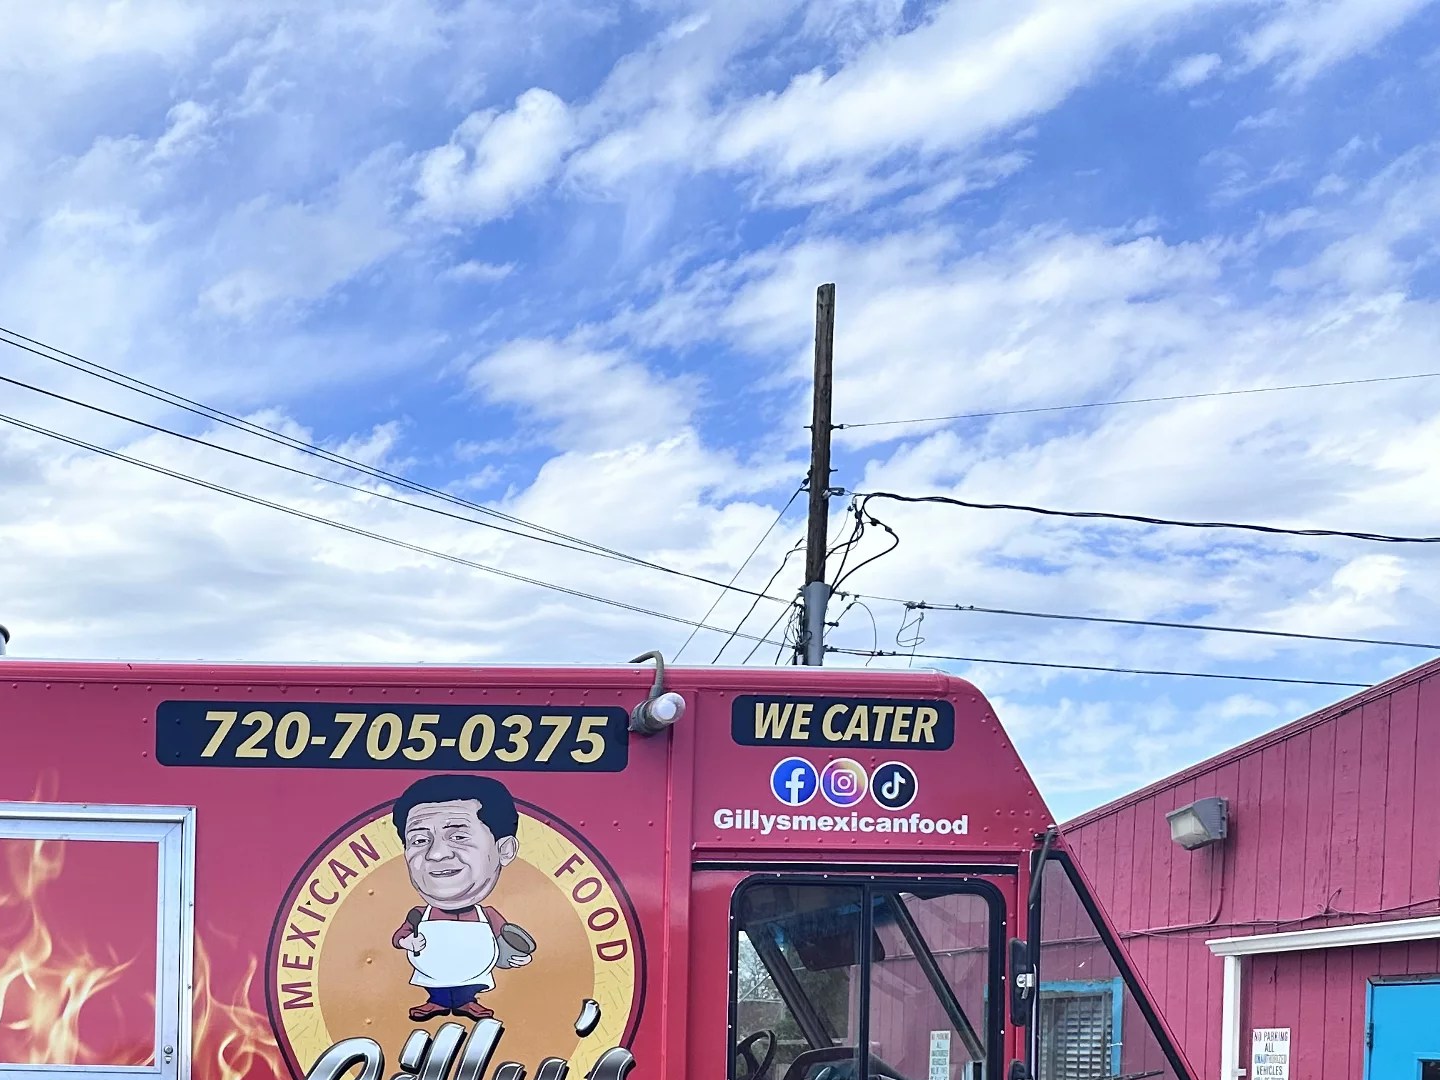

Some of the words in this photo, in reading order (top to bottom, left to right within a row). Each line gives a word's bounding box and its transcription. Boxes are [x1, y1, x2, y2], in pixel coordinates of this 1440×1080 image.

[754, 703, 813, 740] WE
[822, 704, 939, 743] CATER
[200, 710, 609, 764] 720-705-0375
[714, 808, 968, 835] Gillysmexicanfood
[282, 834, 380, 1010] MEXICAN
[554, 853, 628, 962] FOOD
[1254, 1032, 1261, 1041] NO
[1264, 1032, 1288, 1041] PARKING
[1265, 1043, 1274, 1052] ALL
[1257, 1066, 1282, 1075] VEHICLES
